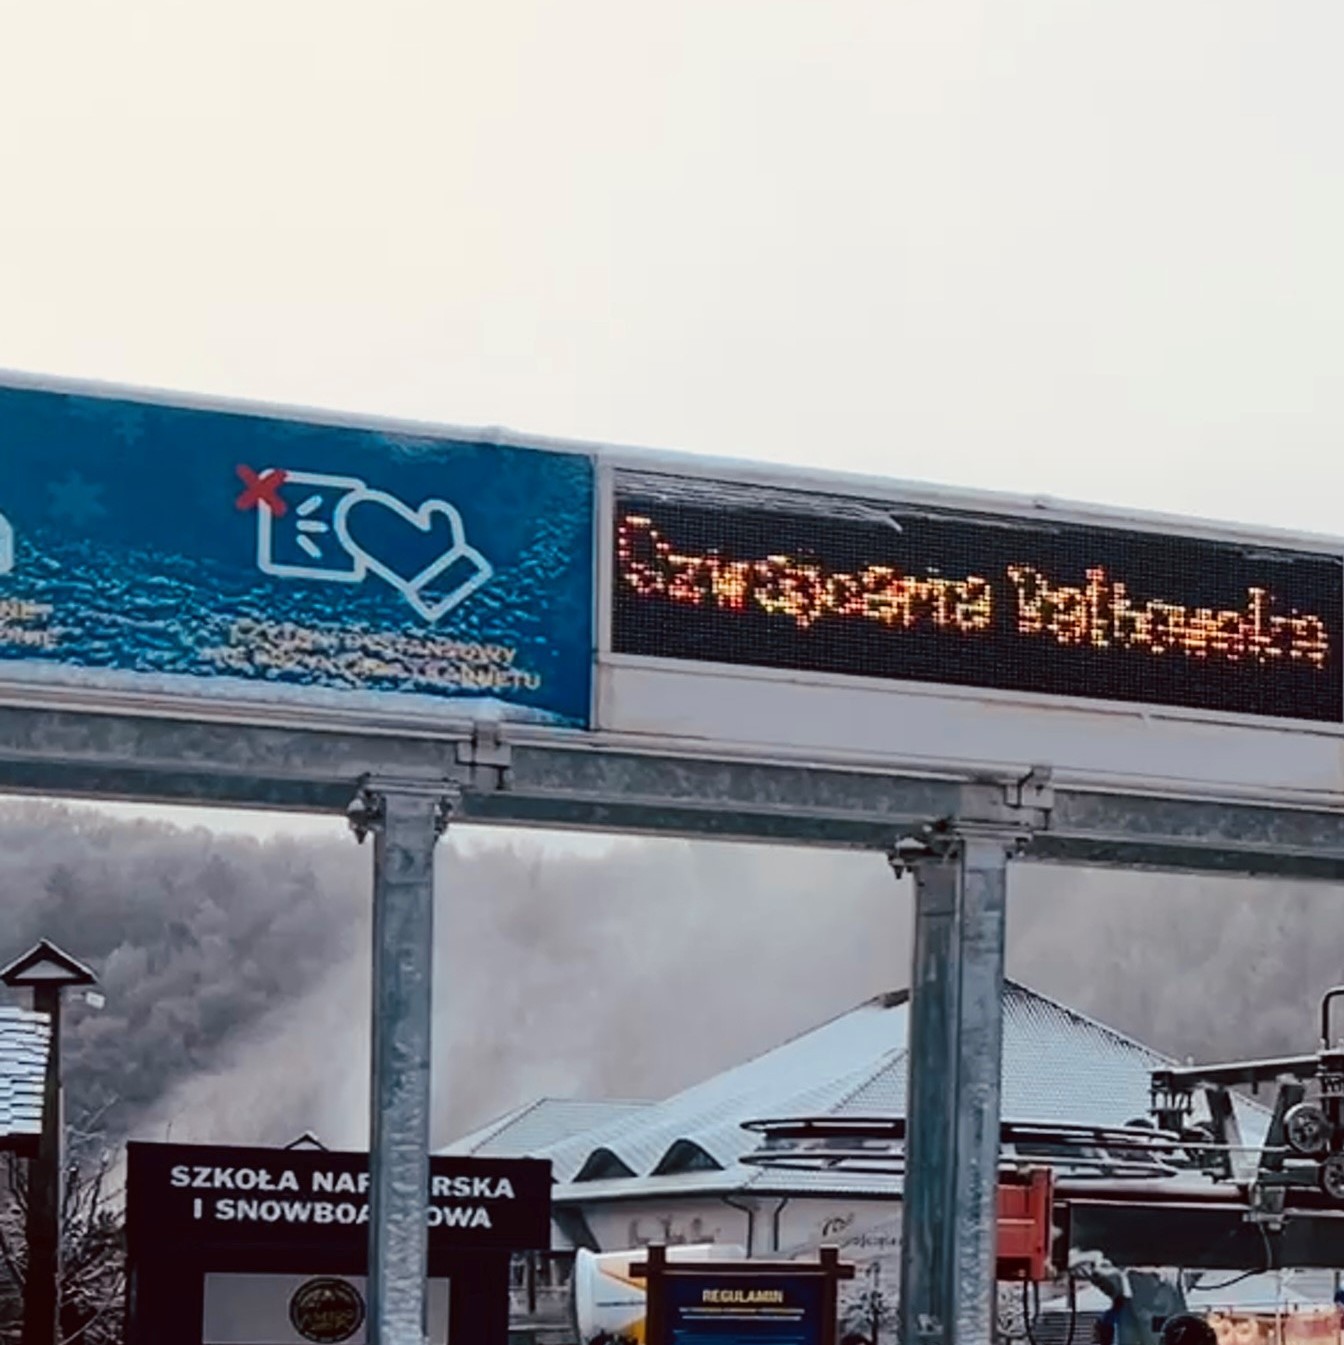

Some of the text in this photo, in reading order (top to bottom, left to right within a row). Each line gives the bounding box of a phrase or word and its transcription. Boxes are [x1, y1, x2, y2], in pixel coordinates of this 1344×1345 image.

[170, 1165, 299, 1192] SZKOŁA
[193, 1198, 203, 1220] I
[702, 1289, 784, 1303] REGULAMIN
